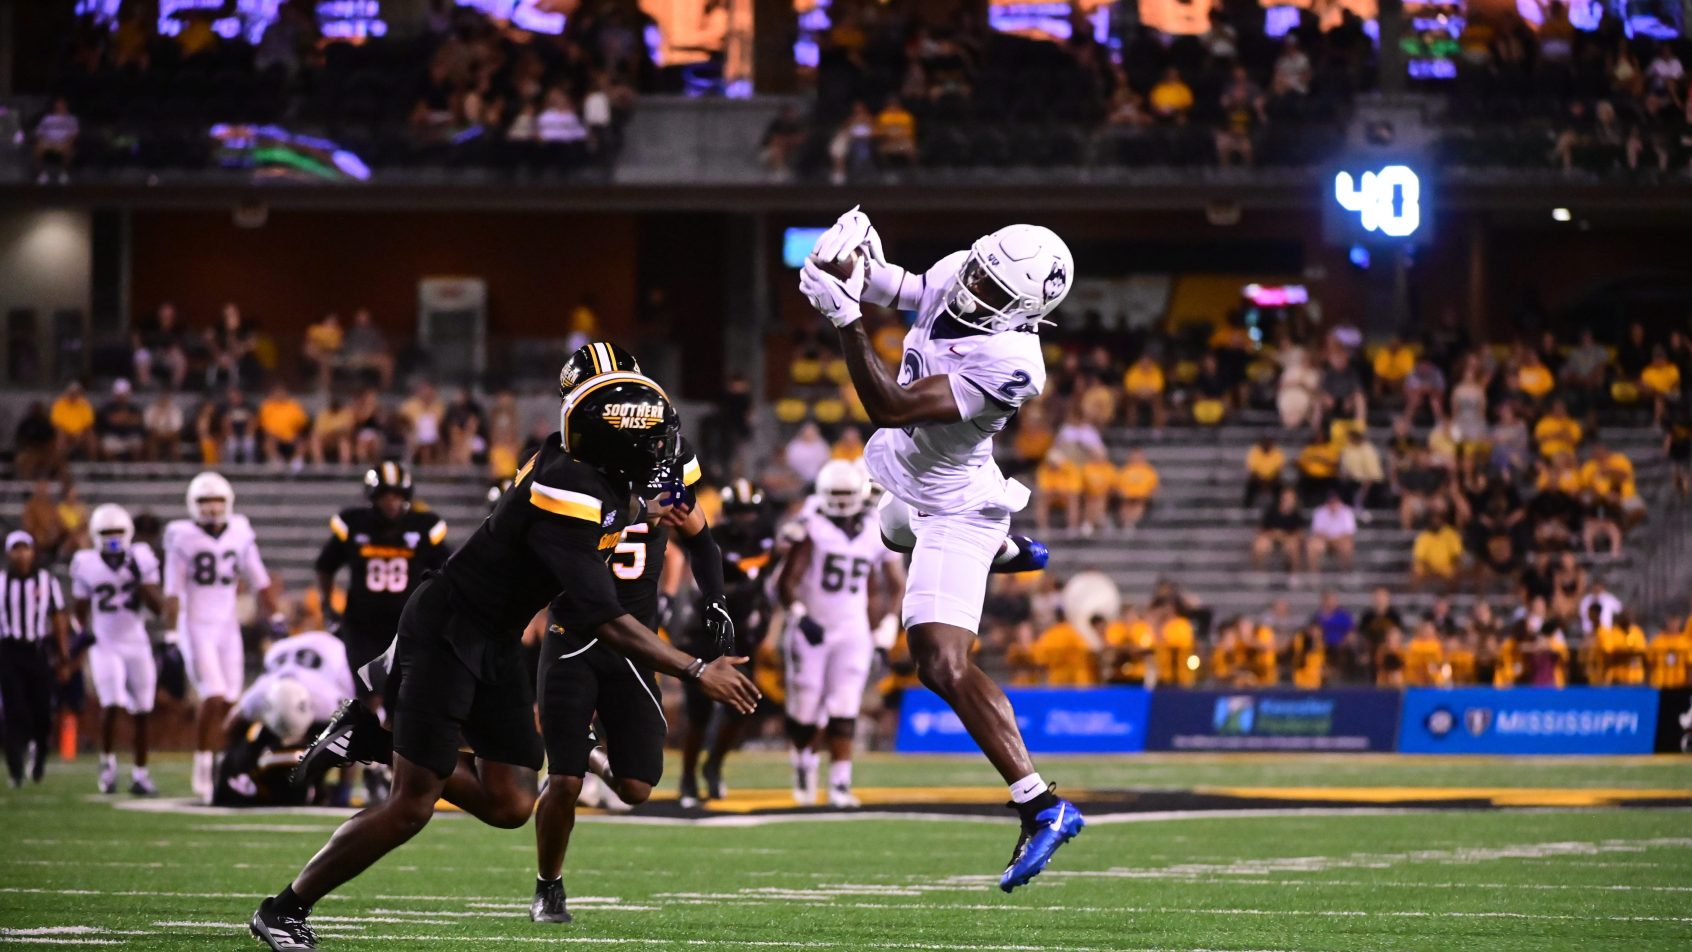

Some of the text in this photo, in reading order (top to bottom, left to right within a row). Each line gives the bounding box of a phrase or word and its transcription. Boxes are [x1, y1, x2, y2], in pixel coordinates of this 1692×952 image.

[1335, 165, 1420, 237] 40
[998, 369, 1031, 400] 2
[601, 403, 664, 419] SOUTHERN
[620, 417, 647, 430] MISS
[613, 522, 649, 580] 5
[194, 551, 240, 586] 83
[366, 557, 409, 592] 88
[1496, 710, 1639, 735] MISSISSIPPI
